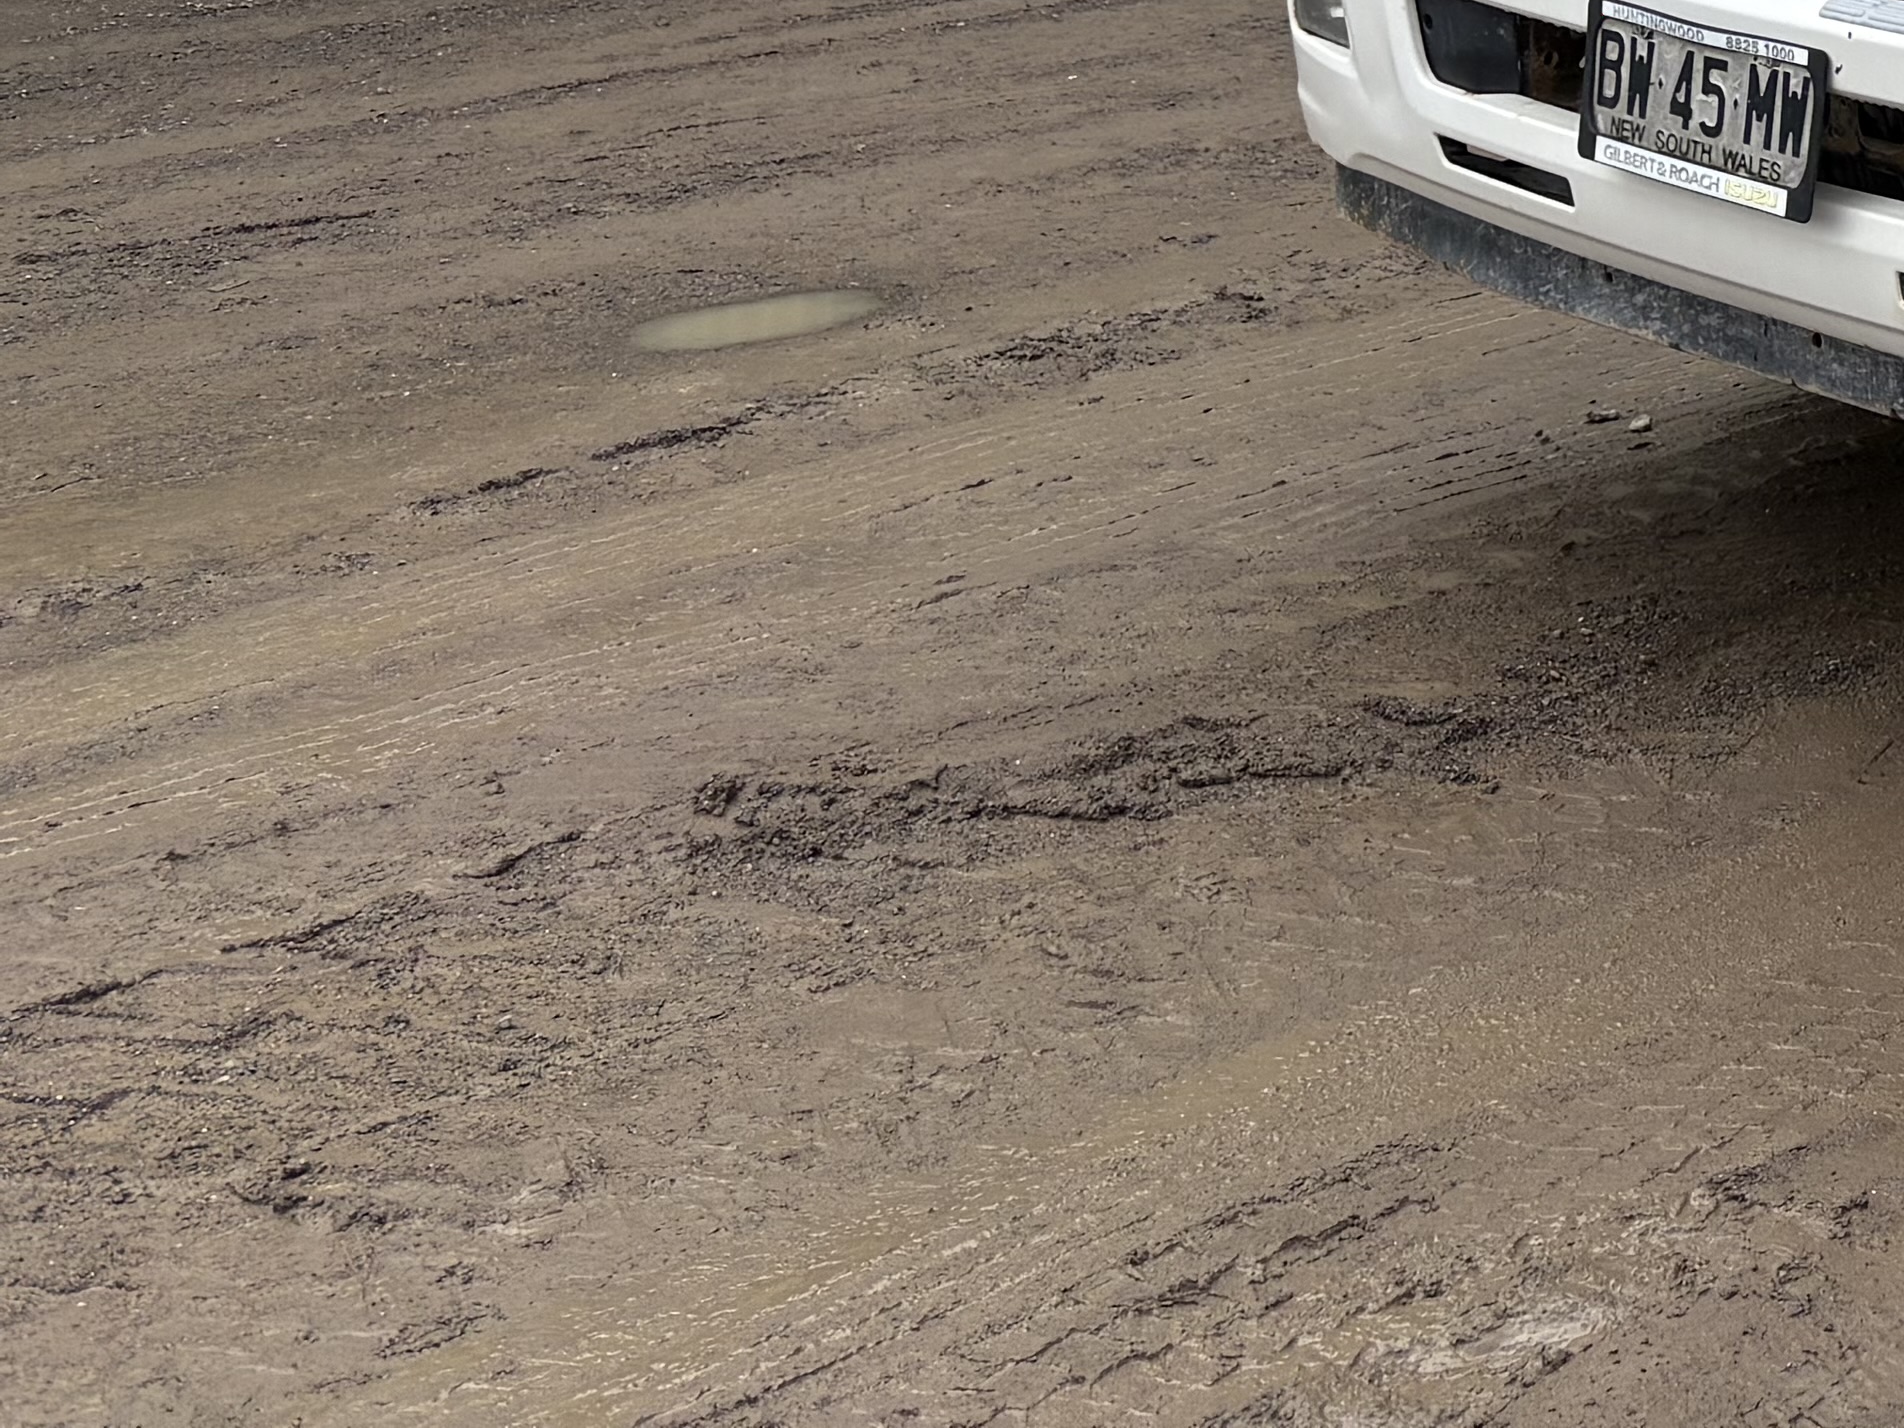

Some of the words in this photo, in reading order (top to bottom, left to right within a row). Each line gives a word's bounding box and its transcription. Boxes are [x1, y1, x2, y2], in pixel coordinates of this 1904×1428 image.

[1612, 7, 1705, 42] HUNTINGWOOD
[1725, 36, 1760, 53] 8825
[1764, 43, 1795, 61] 1000
[1603, 144, 1658, 174] GILBERT
[1668, 164, 1720, 193] ROACH
[1723, 178, 1779, 208] ISUZU
[1610, 116, 1647, 143] NEW
[1655, 129, 1713, 164] SOUTH
[1722, 147, 1782, 183] WALES
